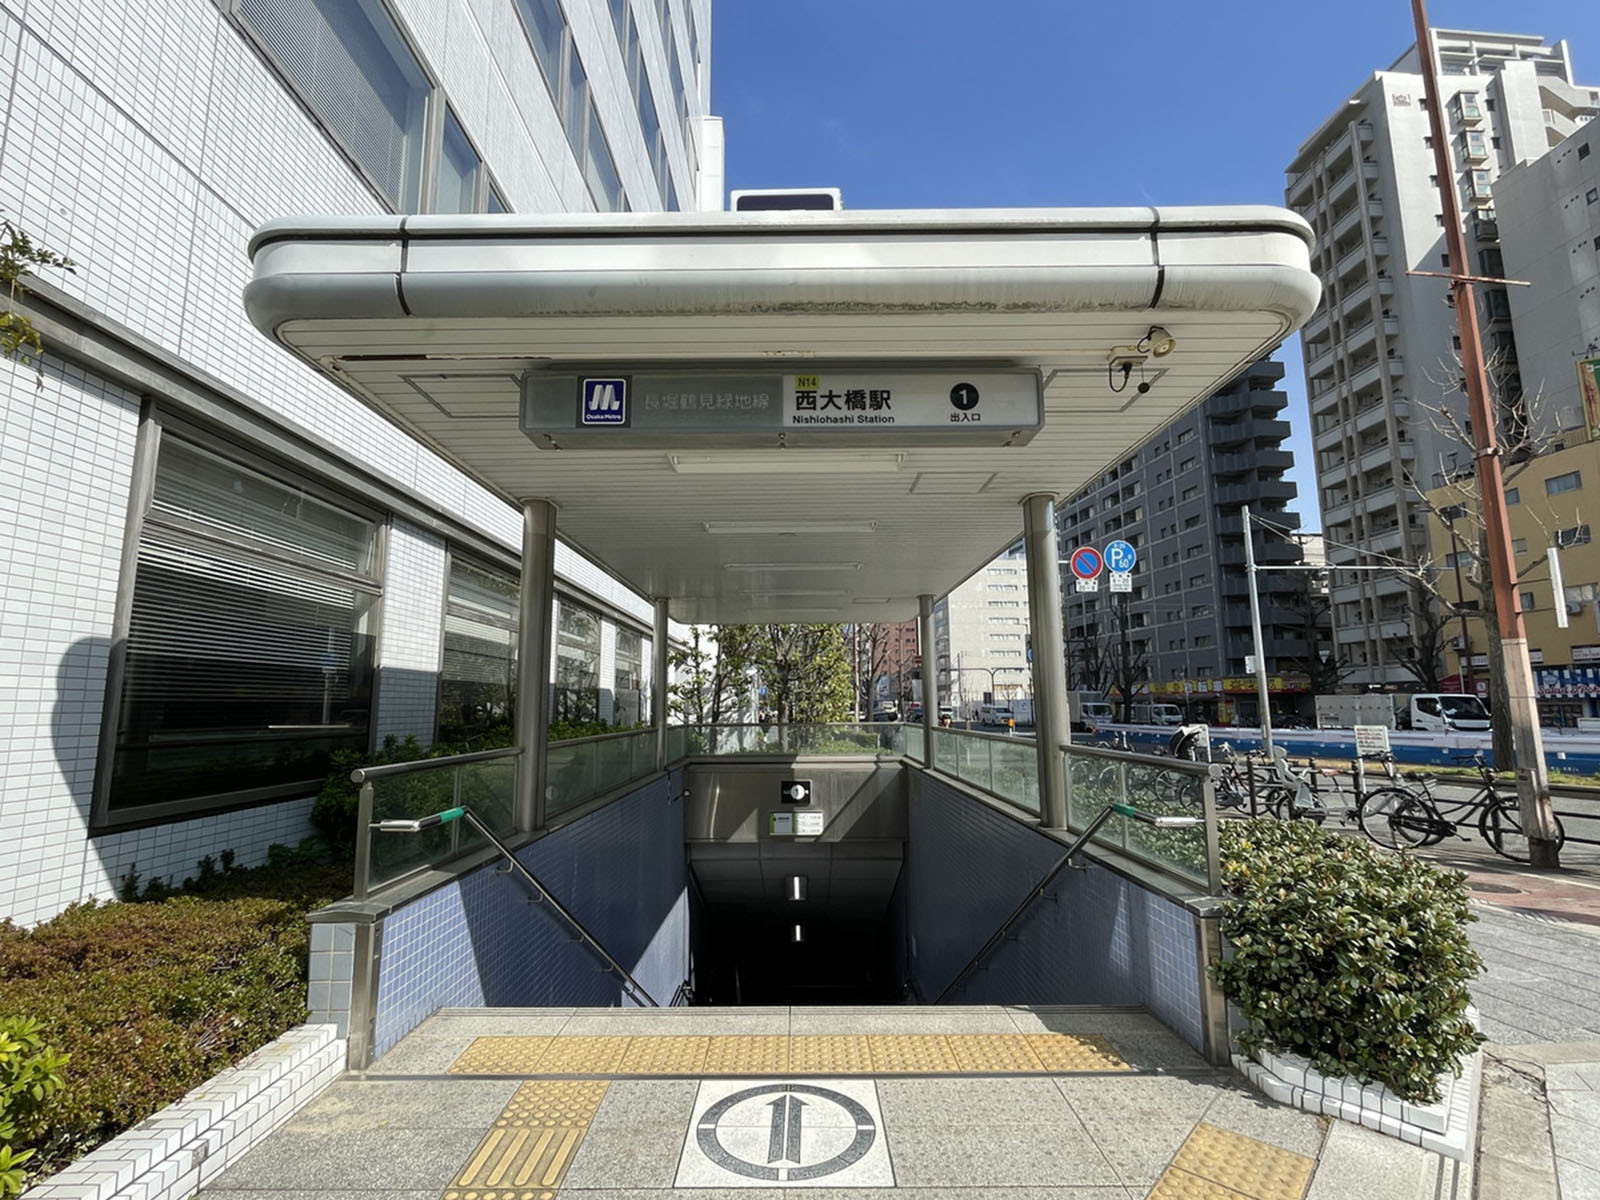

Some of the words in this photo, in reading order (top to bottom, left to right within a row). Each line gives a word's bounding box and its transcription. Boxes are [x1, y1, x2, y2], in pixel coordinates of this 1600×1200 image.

[798, 377, 817, 387] N14
[795, 389, 892, 411] 西大橋駅
[793, 415, 855, 424] Nishiohashi
[857, 415, 895, 424] Station
[950, 413, 981, 423] 出入口
[1111, 548, 1124, 568] P
